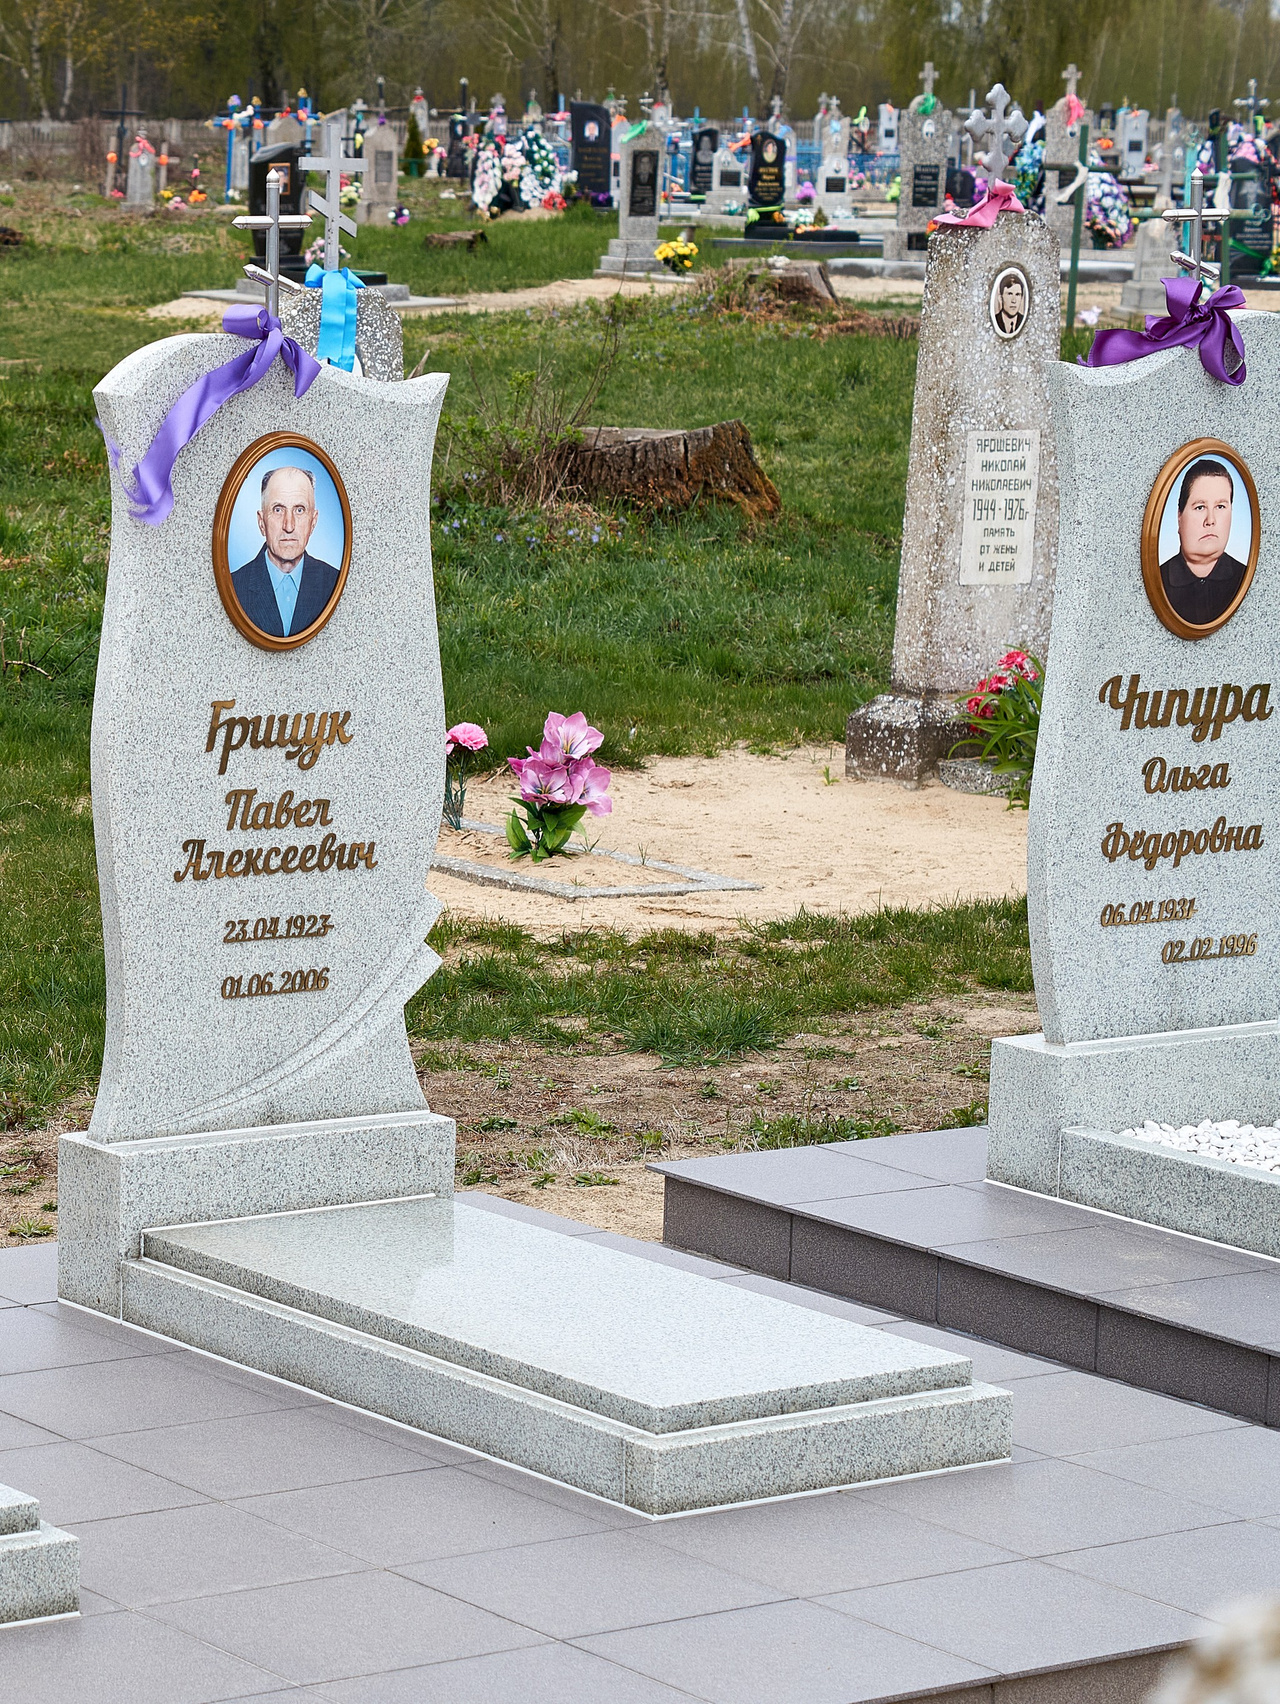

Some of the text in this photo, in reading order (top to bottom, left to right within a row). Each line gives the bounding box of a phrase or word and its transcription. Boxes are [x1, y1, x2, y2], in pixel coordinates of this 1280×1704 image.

[976, 438, 1031, 453] ЯРОШЕВИЧ
[981, 456, 1026, 472] НИКОЛАЙ
[971, 478, 1032, 492] НИКОЛАЕВИЧ
[983, 527, 1015, 538] ПАМЯТЬ
[993, 544, 1018, 554] ЖЕНЫ
[988, 558, 1015, 573] ДЕТЕЙ
[1099, 674, 1274, 744] Чипура
[205, 699, 354, 775] Грищук
[1142, 756, 1232, 795] Ольга
[224, 788, 334, 831] Павел
[174, 833, 379, 883] Алексеевич
[1162, 933, 1259, 964] 02.02.1996
[221, 967, 331, 1000] 01.06.2006
